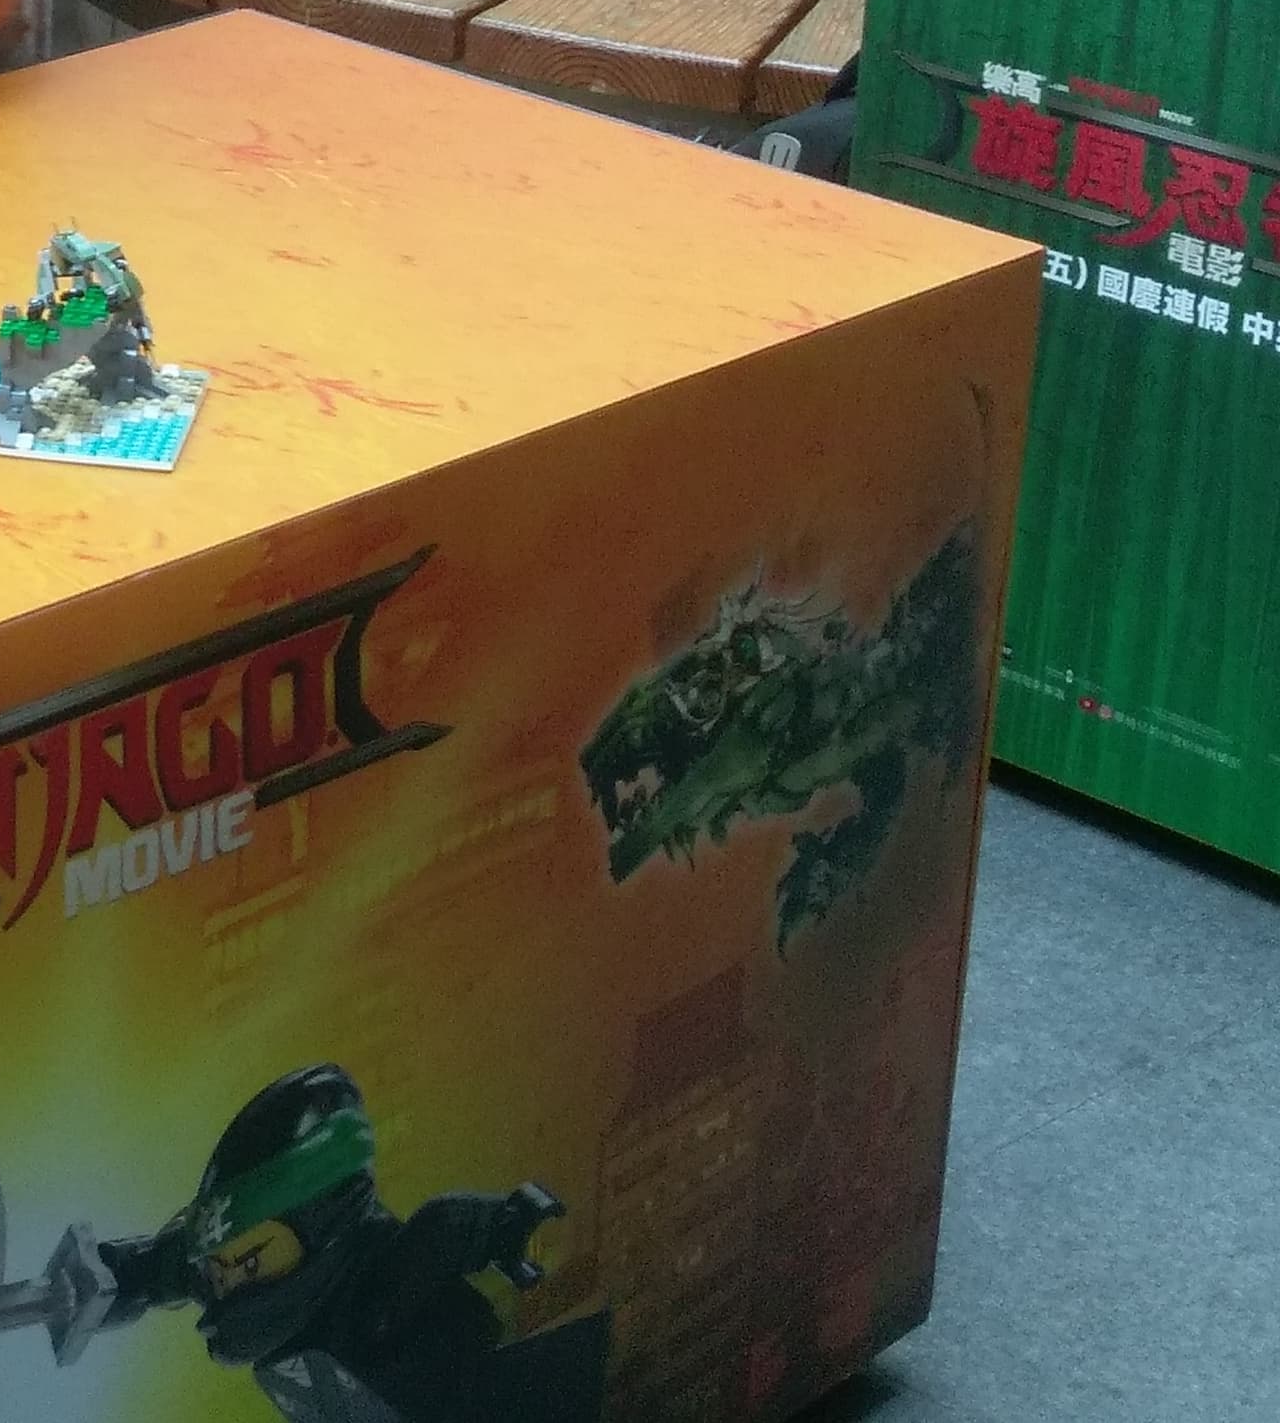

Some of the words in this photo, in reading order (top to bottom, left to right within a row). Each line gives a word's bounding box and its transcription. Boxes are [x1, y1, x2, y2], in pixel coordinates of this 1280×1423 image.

[968, 94, 1280, 266] 旋風忍
[1097, 264, 1230, 335] 國慶連假
[1242, 311, 1280, 353] 中
[1167, 231, 1245, 288] 電影
[63, 790, 255, 920] MOVIE
